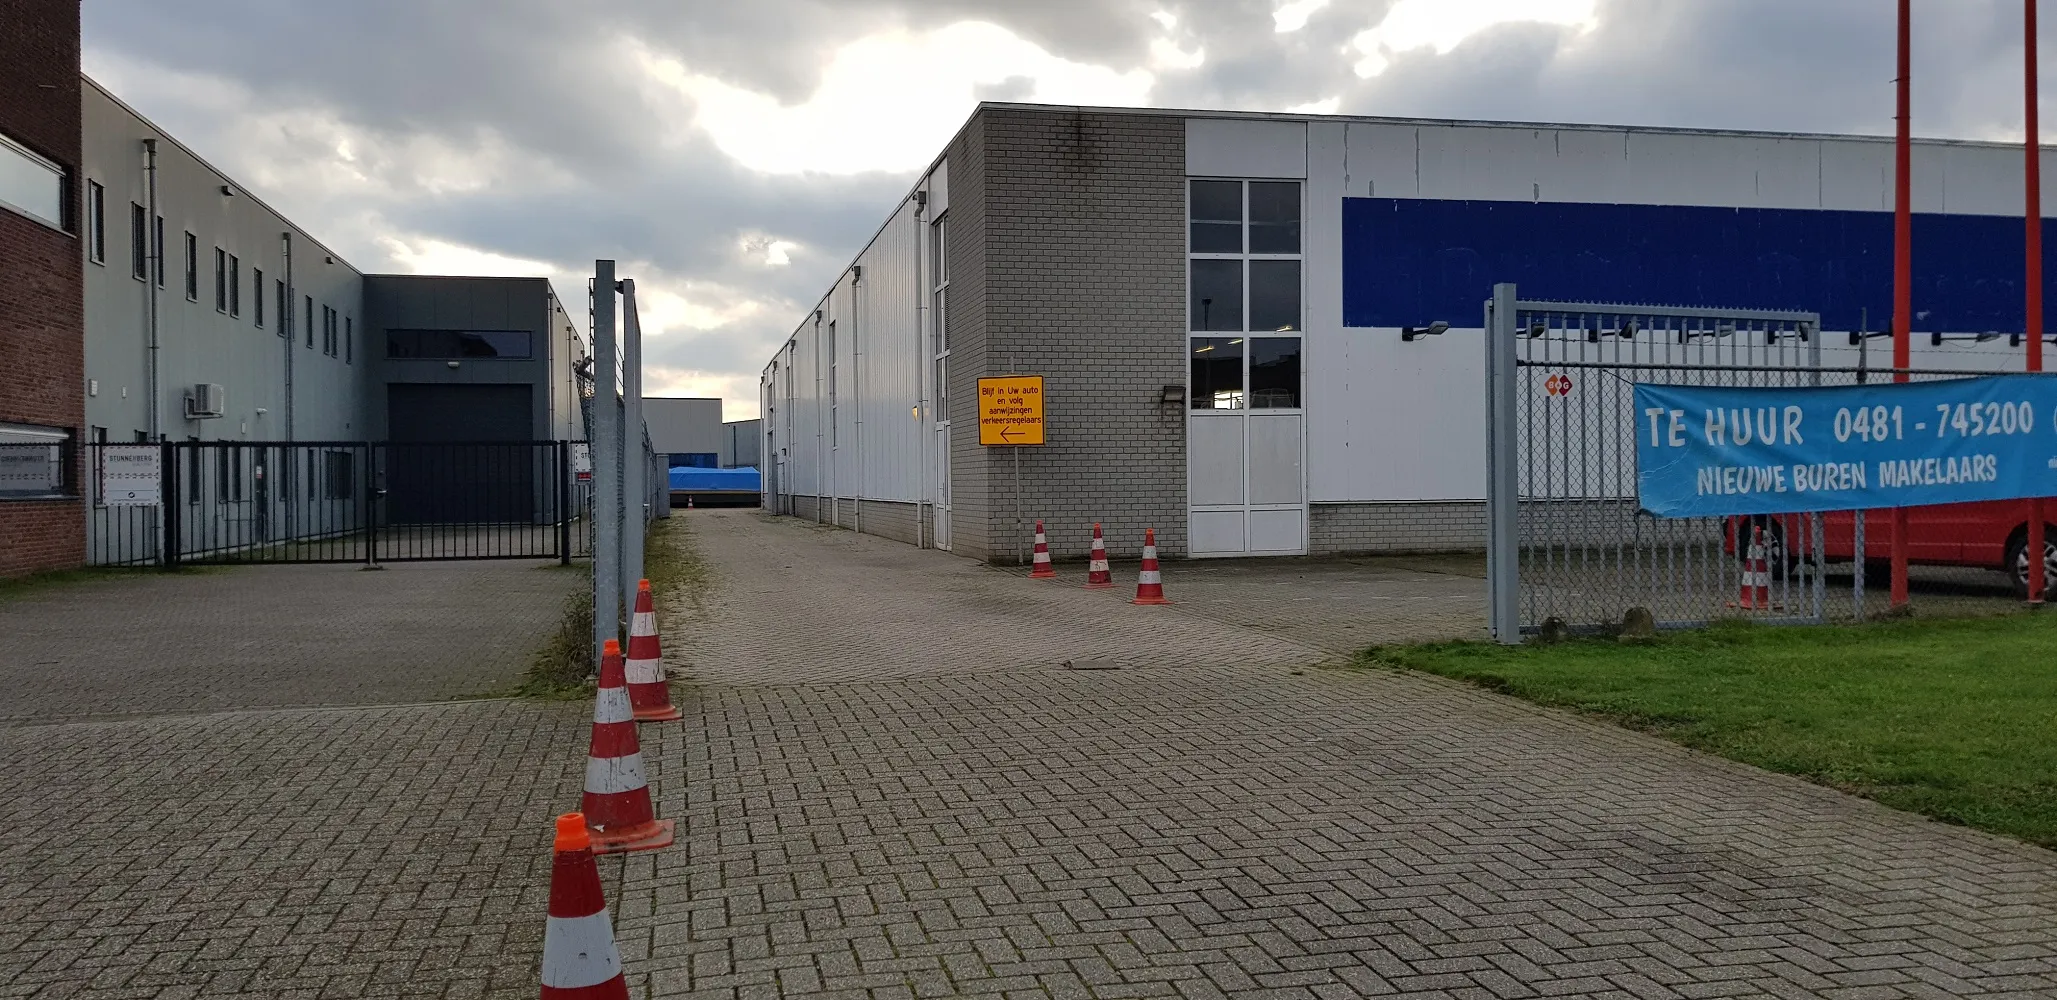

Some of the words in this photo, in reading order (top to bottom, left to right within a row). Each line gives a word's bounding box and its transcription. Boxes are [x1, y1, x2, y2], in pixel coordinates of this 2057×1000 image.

[982, 387, 995, 397] Blijf
[1007, 386, 1019, 395] Uw
[1022, 386, 1039, 394] auto
[1009, 396, 1023, 406] volg
[988, 407, 1033, 416] aanwijzingen
[981, 416, 1042, 426] verkeersregelaars
[1645, 407, 1687, 447] TE
[1705, 405, 1804, 446] HUUR
[1834, 405, 1903, 442] 0481
[1936, 401, 2033, 438] 745200
[1697, 465, 1787, 496] NIEUWE
[1793, 461, 1866, 492] BUREN
[1879, 454, 1997, 488] MAKELAARS
